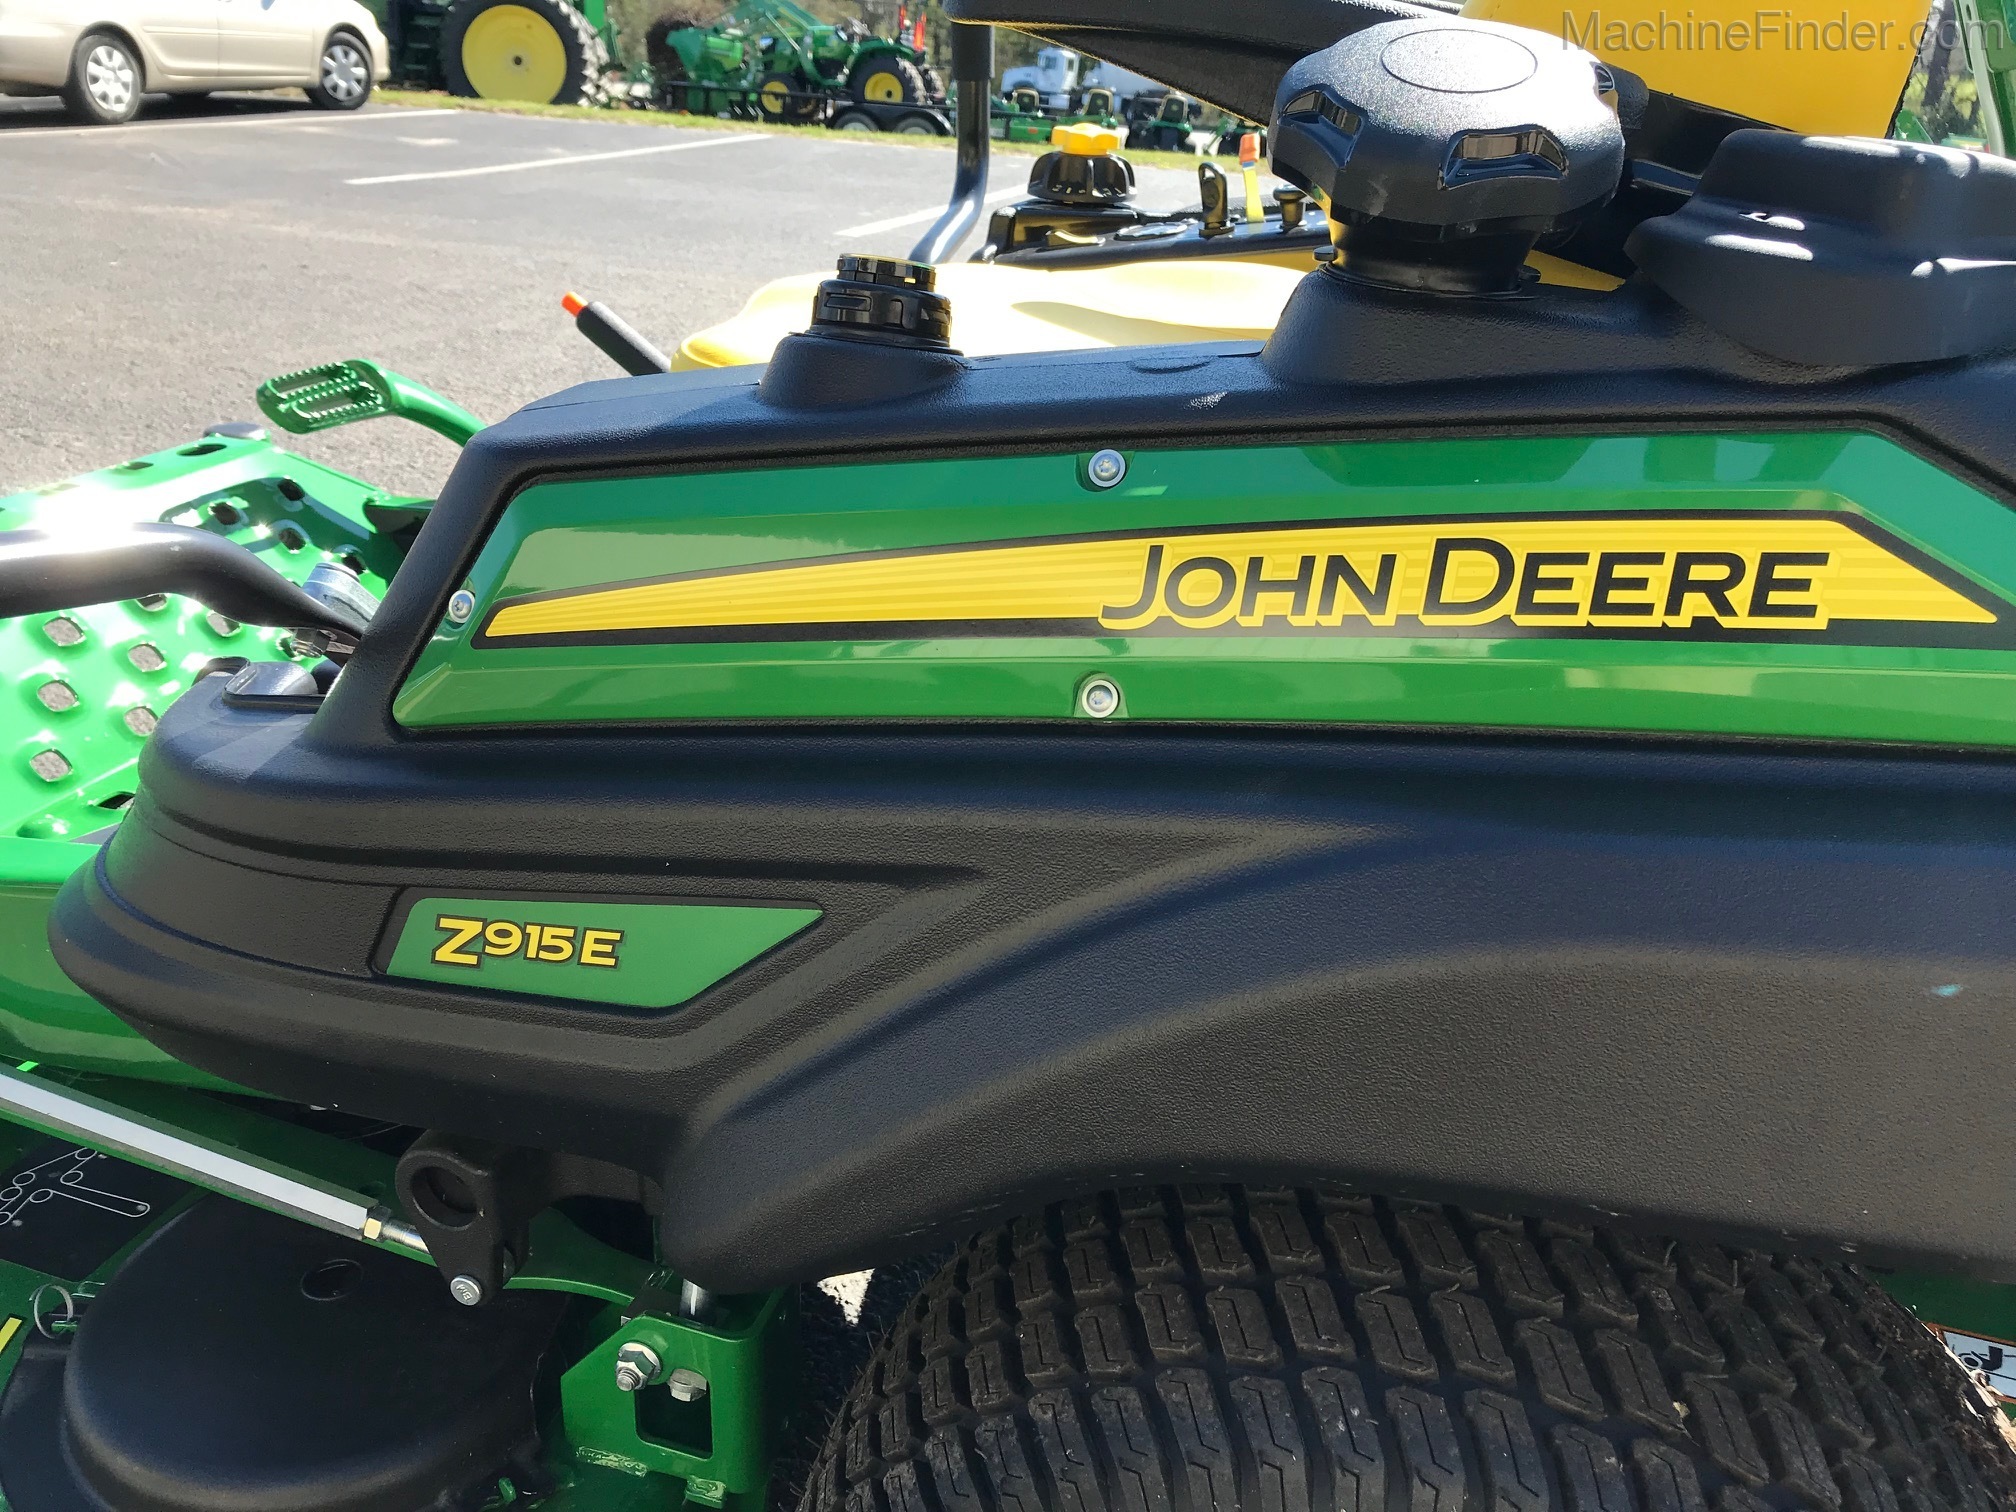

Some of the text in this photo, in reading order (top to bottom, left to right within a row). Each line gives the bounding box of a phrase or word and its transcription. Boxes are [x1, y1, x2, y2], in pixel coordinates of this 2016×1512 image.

[1099, 537, 1831, 624] JOHN DEERE
[432, 914, 624, 968] Z915E
